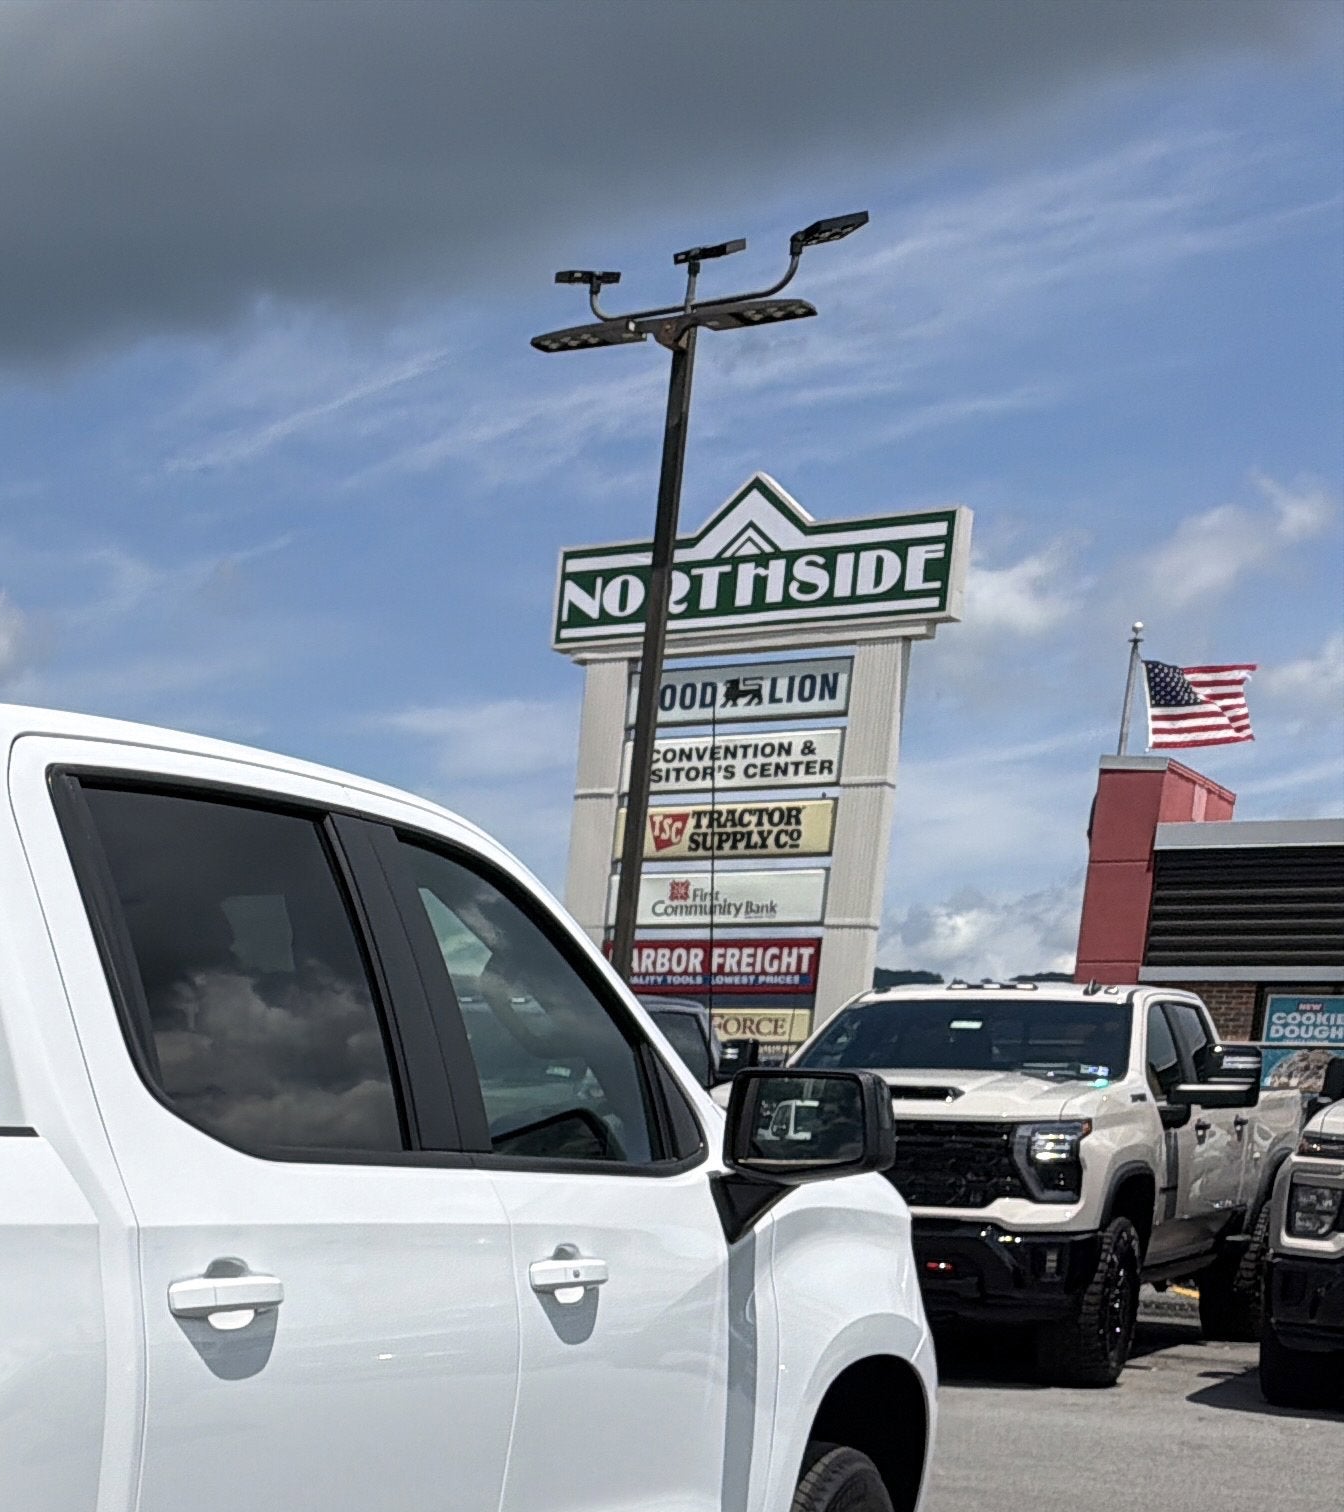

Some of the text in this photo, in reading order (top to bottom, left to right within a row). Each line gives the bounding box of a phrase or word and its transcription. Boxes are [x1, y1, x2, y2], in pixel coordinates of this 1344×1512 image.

[659, 672, 839, 711] OOD LION
[651, 740, 816, 764] CONVENTION &
[650, 760, 834, 783] SITOR'S CENTER
[691, 806, 802, 829] TRACTOR
[653, 815, 683, 844] TSC
[688, 829, 772, 852] SUPPLY
[652, 898, 777, 918] Community Bank
[609, 946, 814, 974] ARBOR FREIGHT
[666, 975, 703, 985] TOOLS
[759, 974, 800, 985] PRICES
[1270, 1025, 1344, 1038] DOUGH
